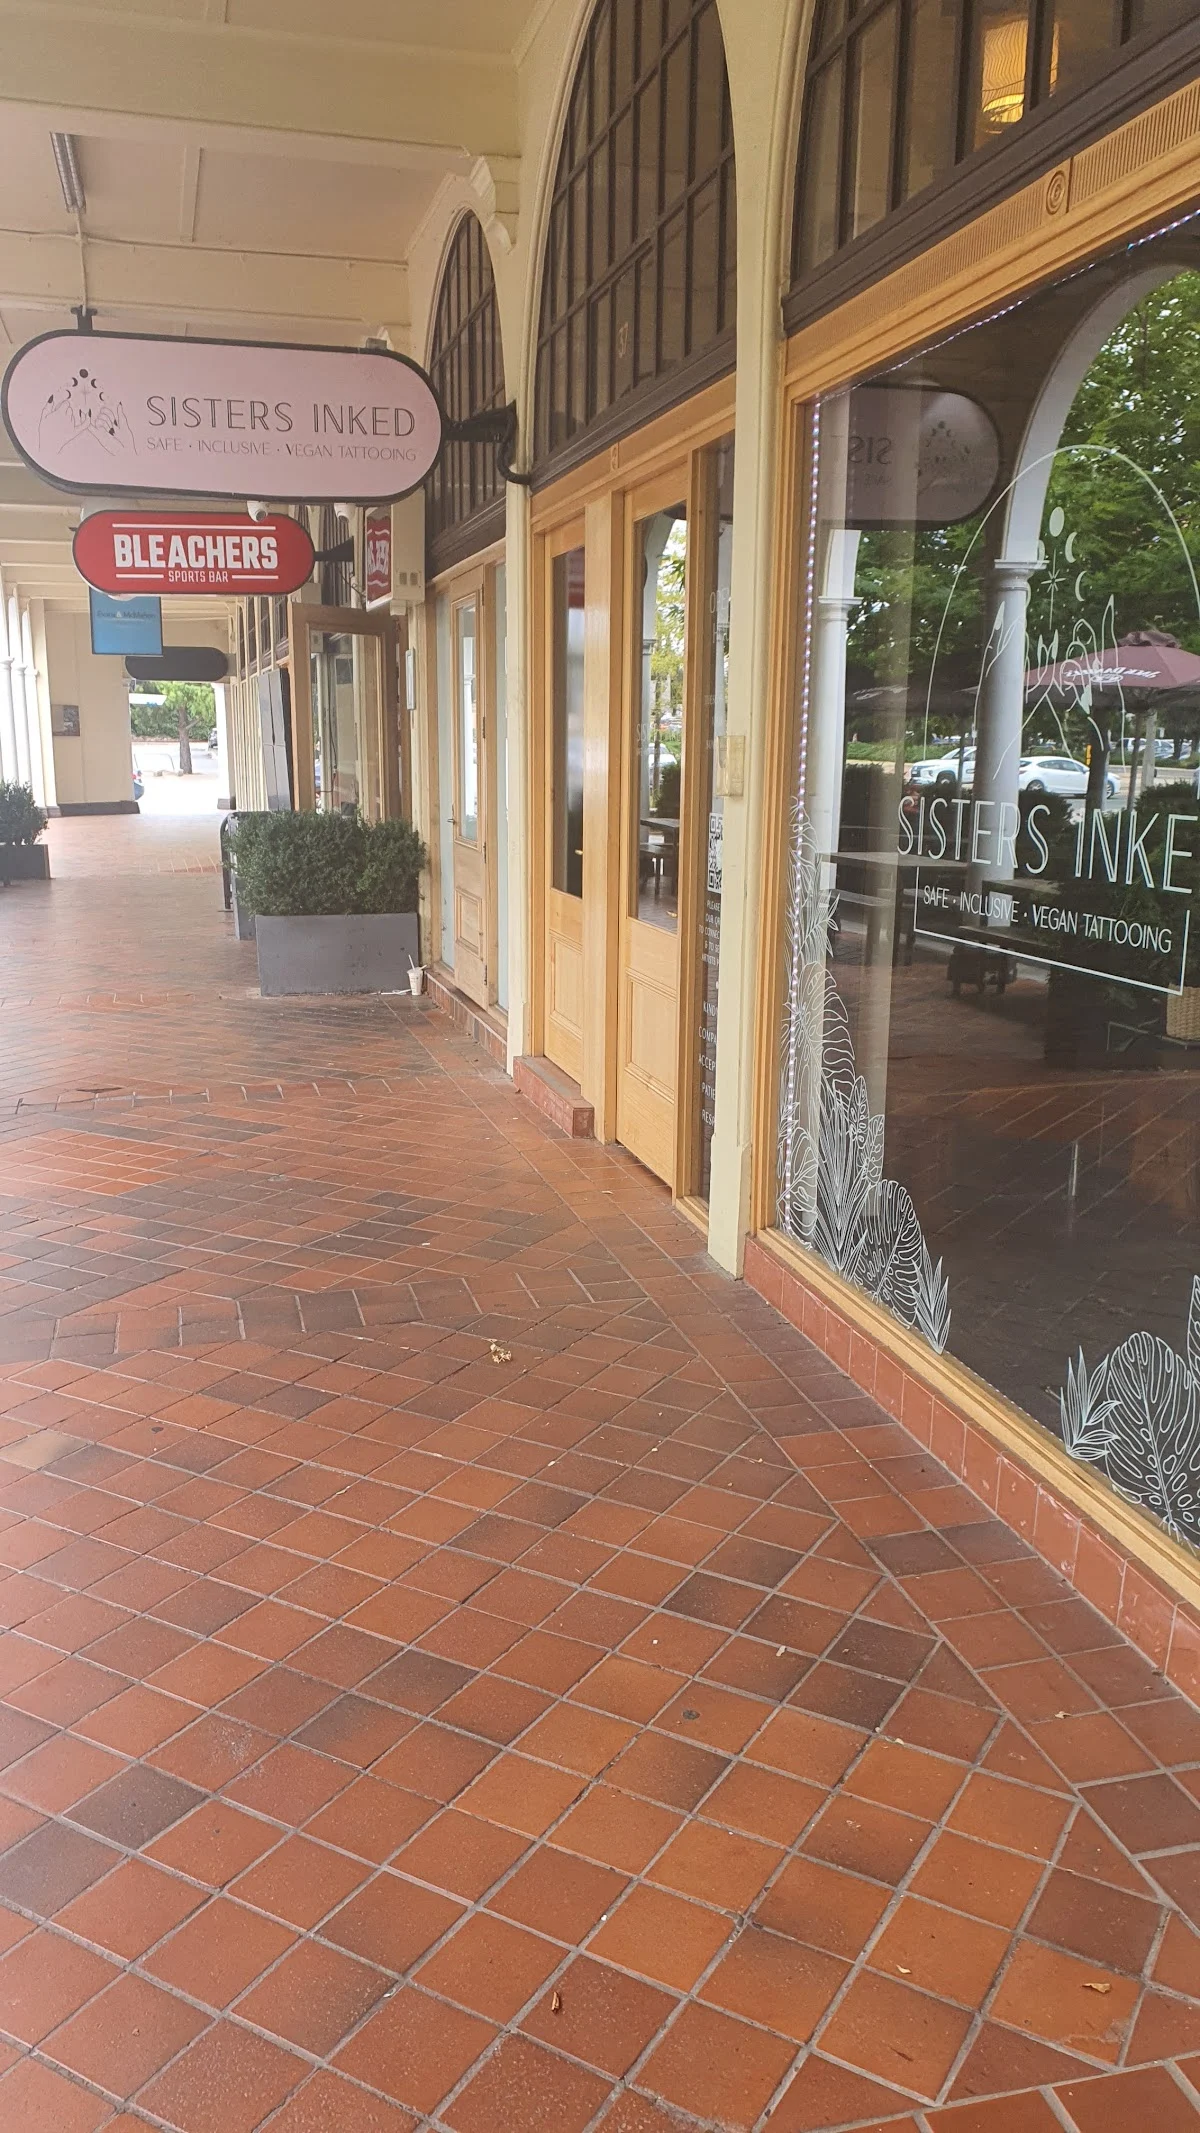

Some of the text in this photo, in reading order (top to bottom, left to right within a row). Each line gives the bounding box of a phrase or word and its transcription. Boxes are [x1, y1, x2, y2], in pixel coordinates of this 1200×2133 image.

[146, 395, 416, 437] SISTERS INKED
[147, 437, 417, 462] SAFE INCLUSIVE VEGAN TATTOOING
[113, 534, 278, 570] BLEACHERS
[168, 570, 229, 583] SPORTS BAR
[896, 796, 1199, 894] SISTERS INKE
[923, 885, 1172, 954] SAFE INCLUSIVE VEGAN TATTOOING
